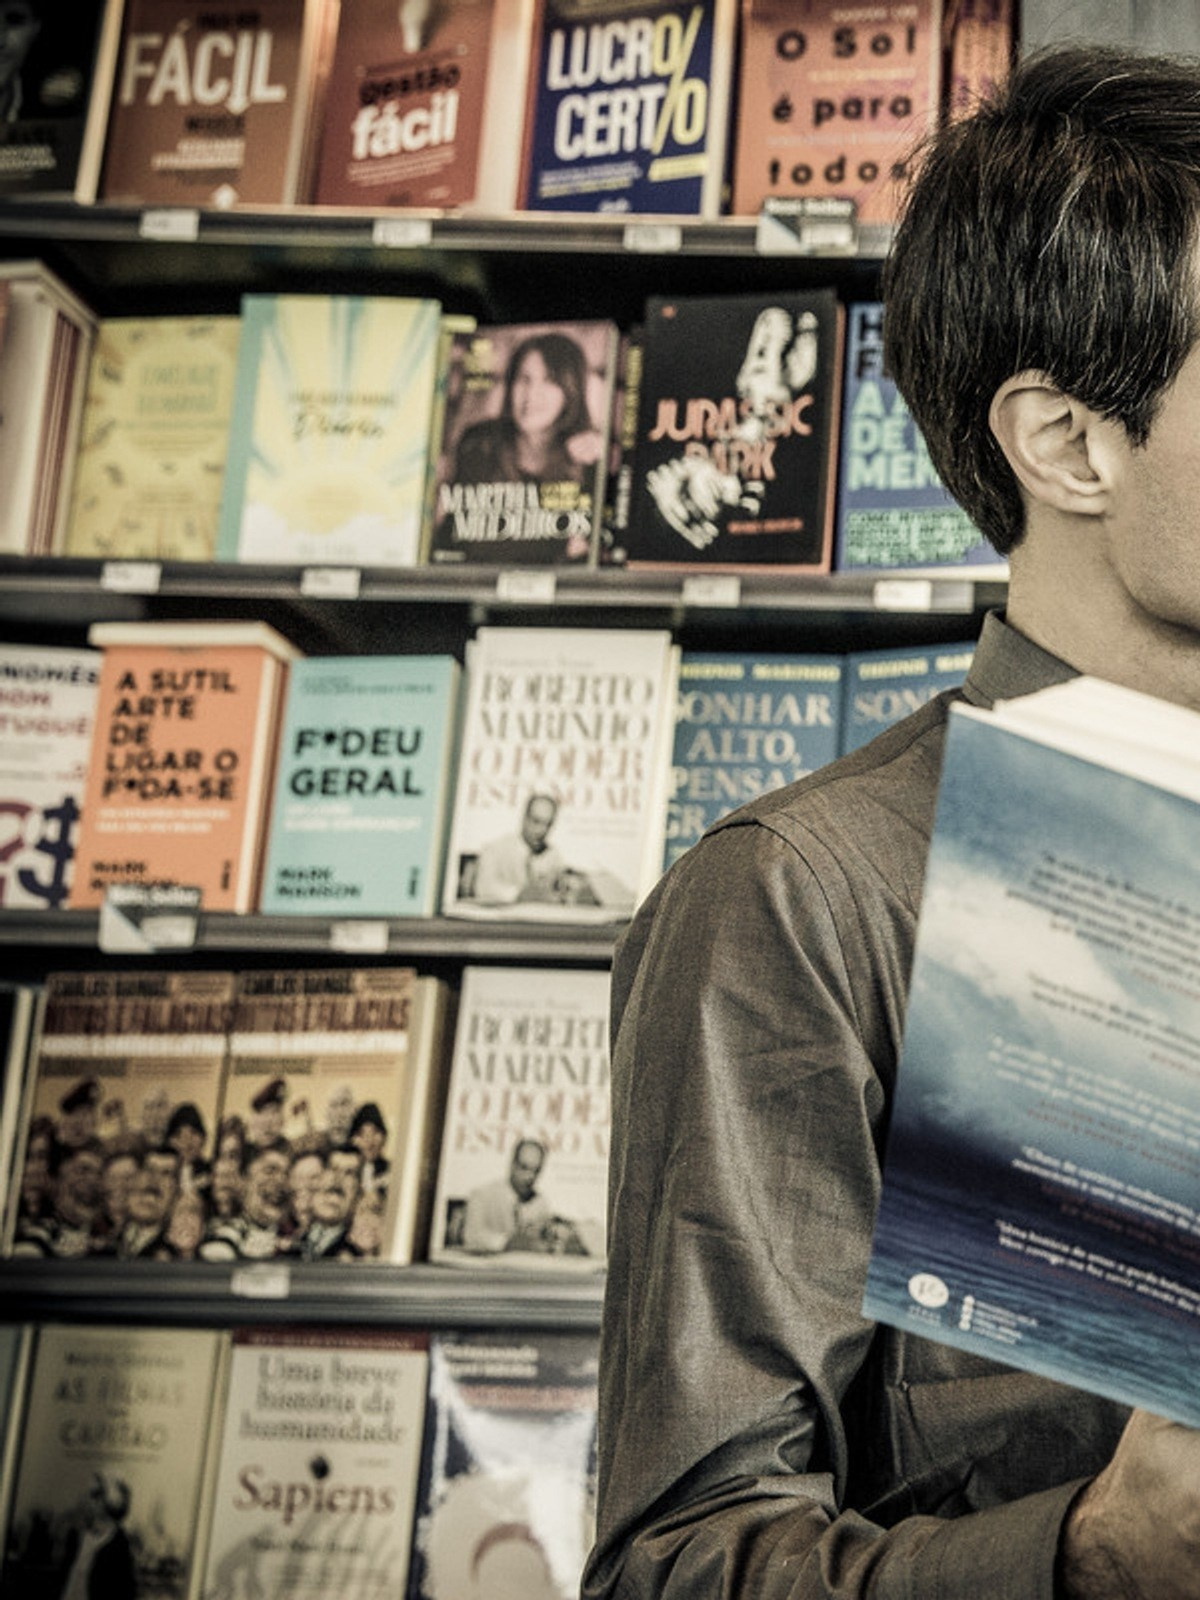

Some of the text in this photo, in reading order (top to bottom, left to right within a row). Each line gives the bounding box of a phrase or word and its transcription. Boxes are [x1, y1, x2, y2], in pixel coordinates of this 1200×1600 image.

[833, 23, 916, 59] Sol
[121, 17, 287, 114] FÁCIL
[351, 89, 460, 160] fácil
[772, 92, 913, 128] é para
[768, 156, 912, 185] todos
[118, 671, 237, 692] A SUTIL
[482, 672, 655, 702] ROBERTO
[112, 697, 195, 719] ARTE
[109, 725, 149, 746] DE
[476, 710, 651, 743] MARINHO
[106, 750, 238, 772] LIGAR O
[511, 749, 642, 781] PODER
[290, 768, 423, 797] GERAL
[234, 1464, 395, 1525] Sapiens
